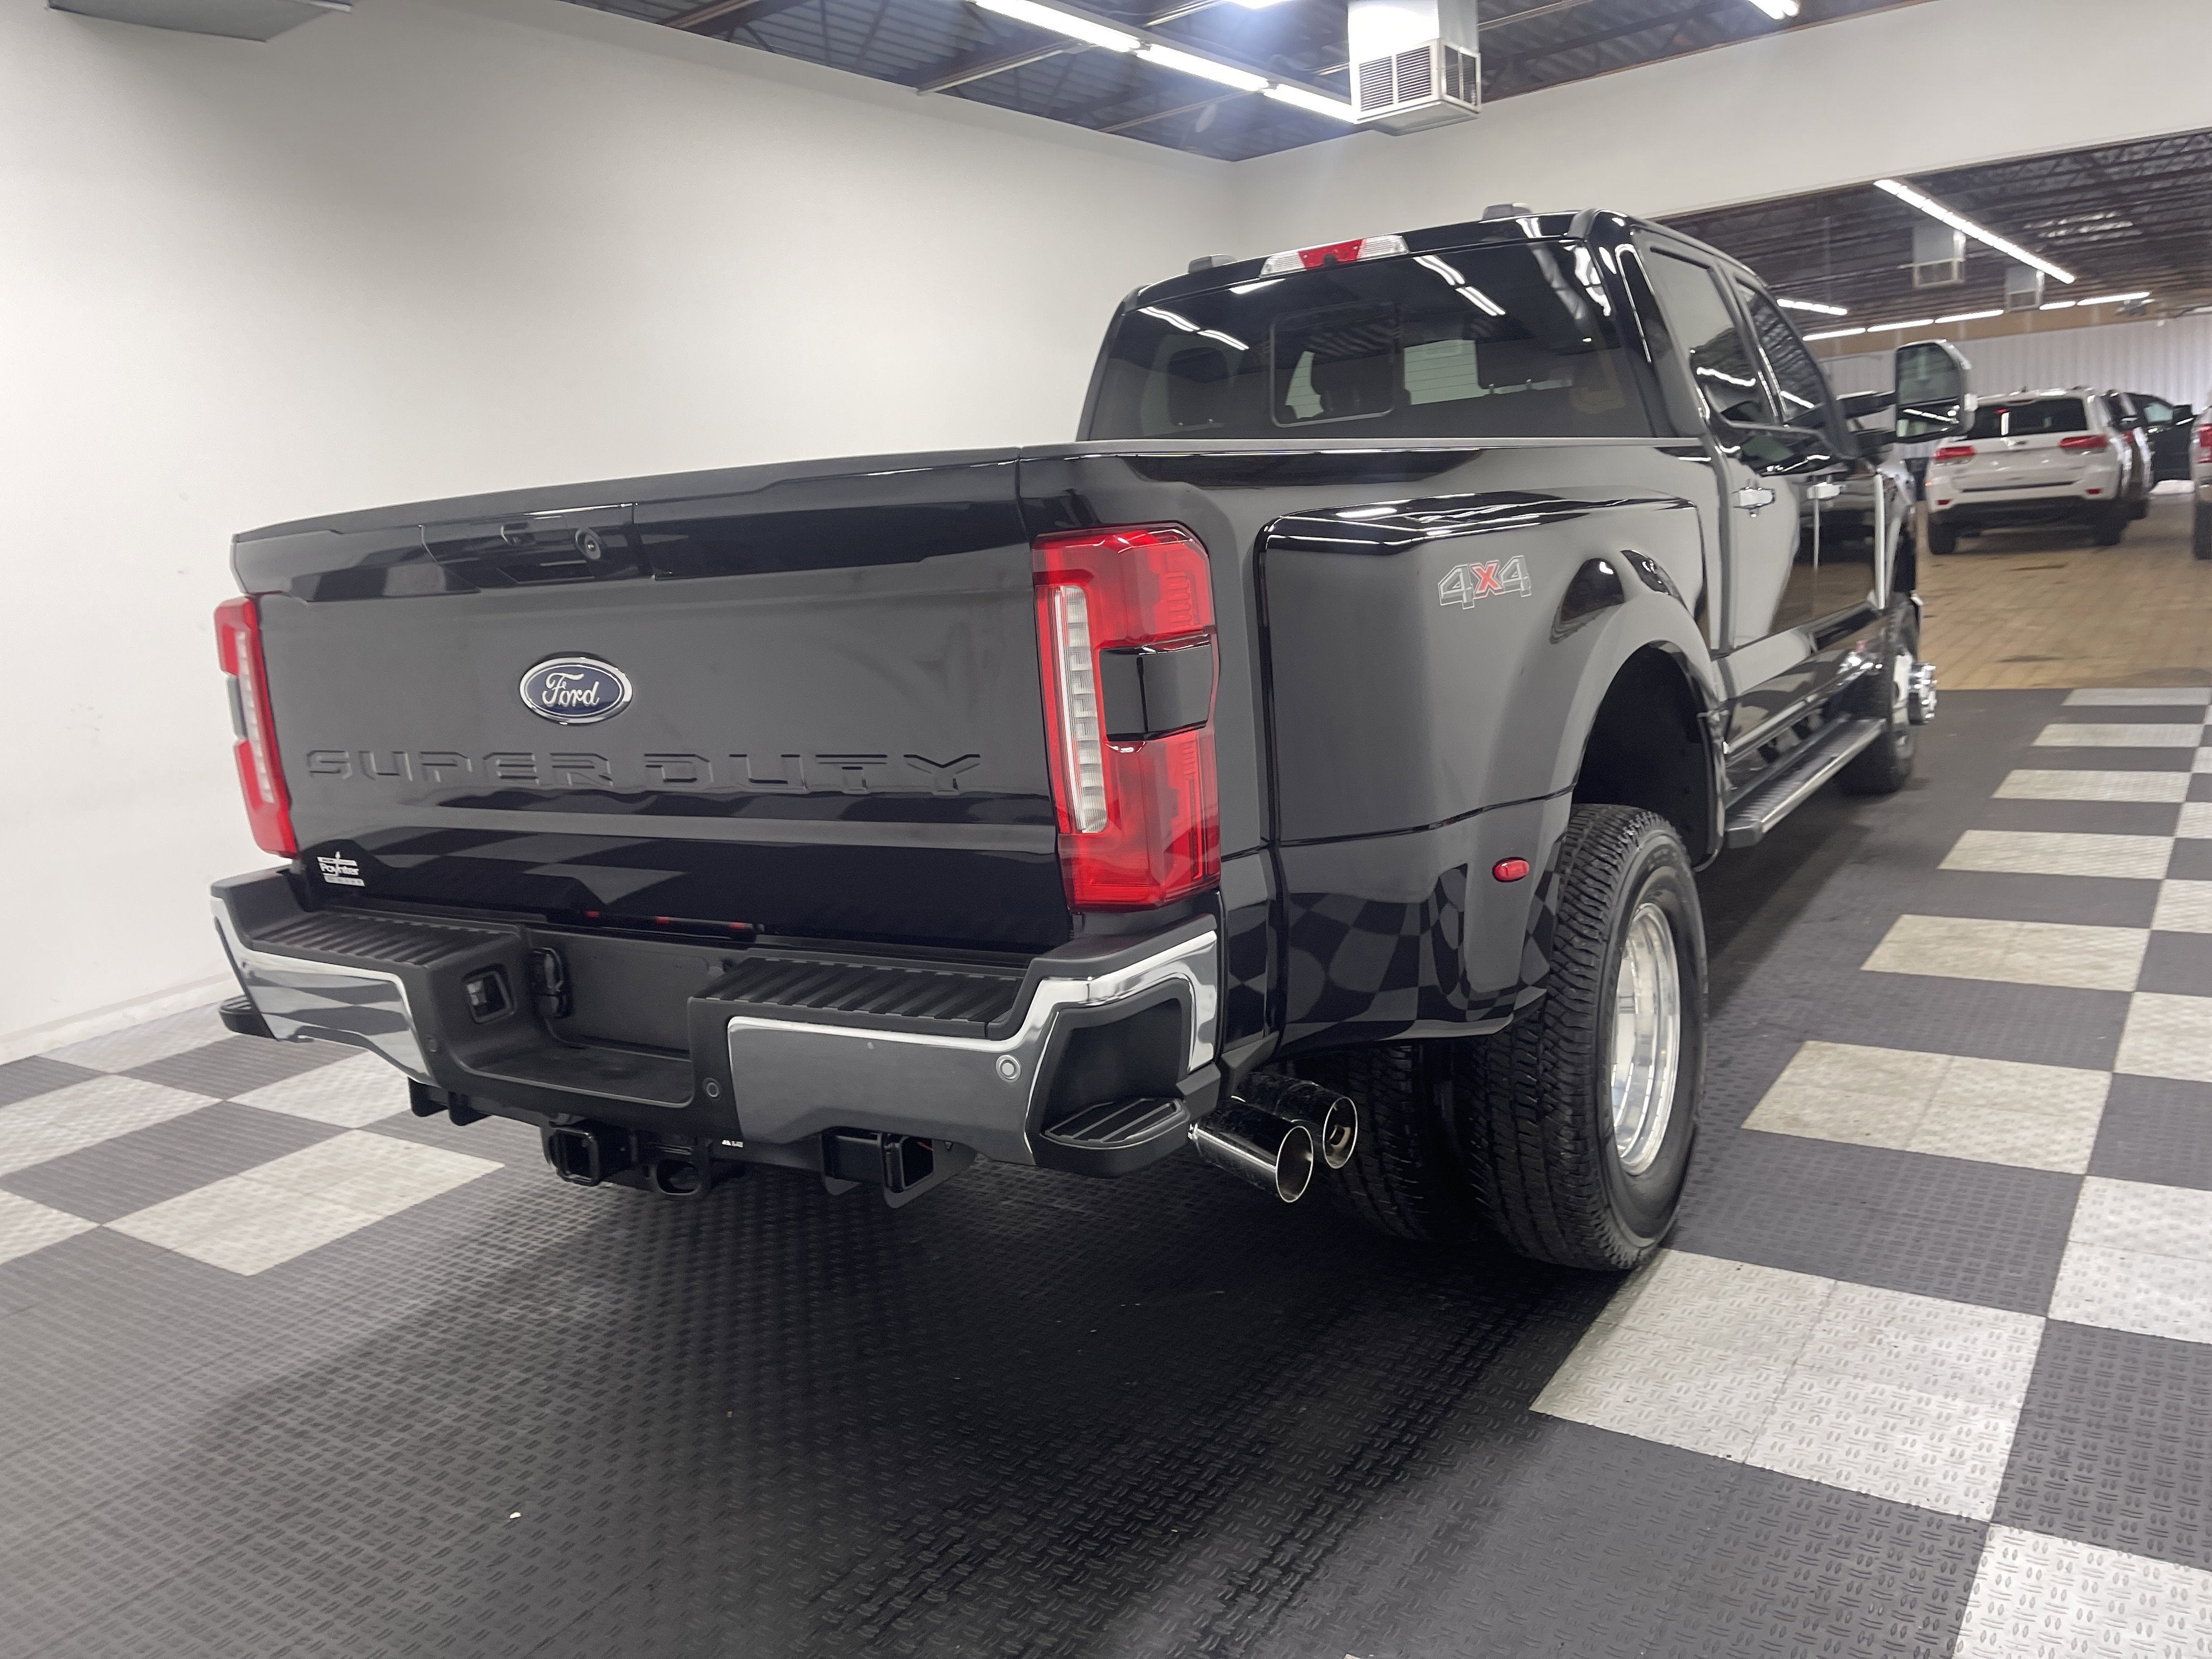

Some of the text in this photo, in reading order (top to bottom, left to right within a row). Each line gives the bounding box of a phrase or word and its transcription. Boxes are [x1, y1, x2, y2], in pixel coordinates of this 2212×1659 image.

[541, 672, 600, 707] Ford
[306, 750, 981, 794] SUPER DUTY
